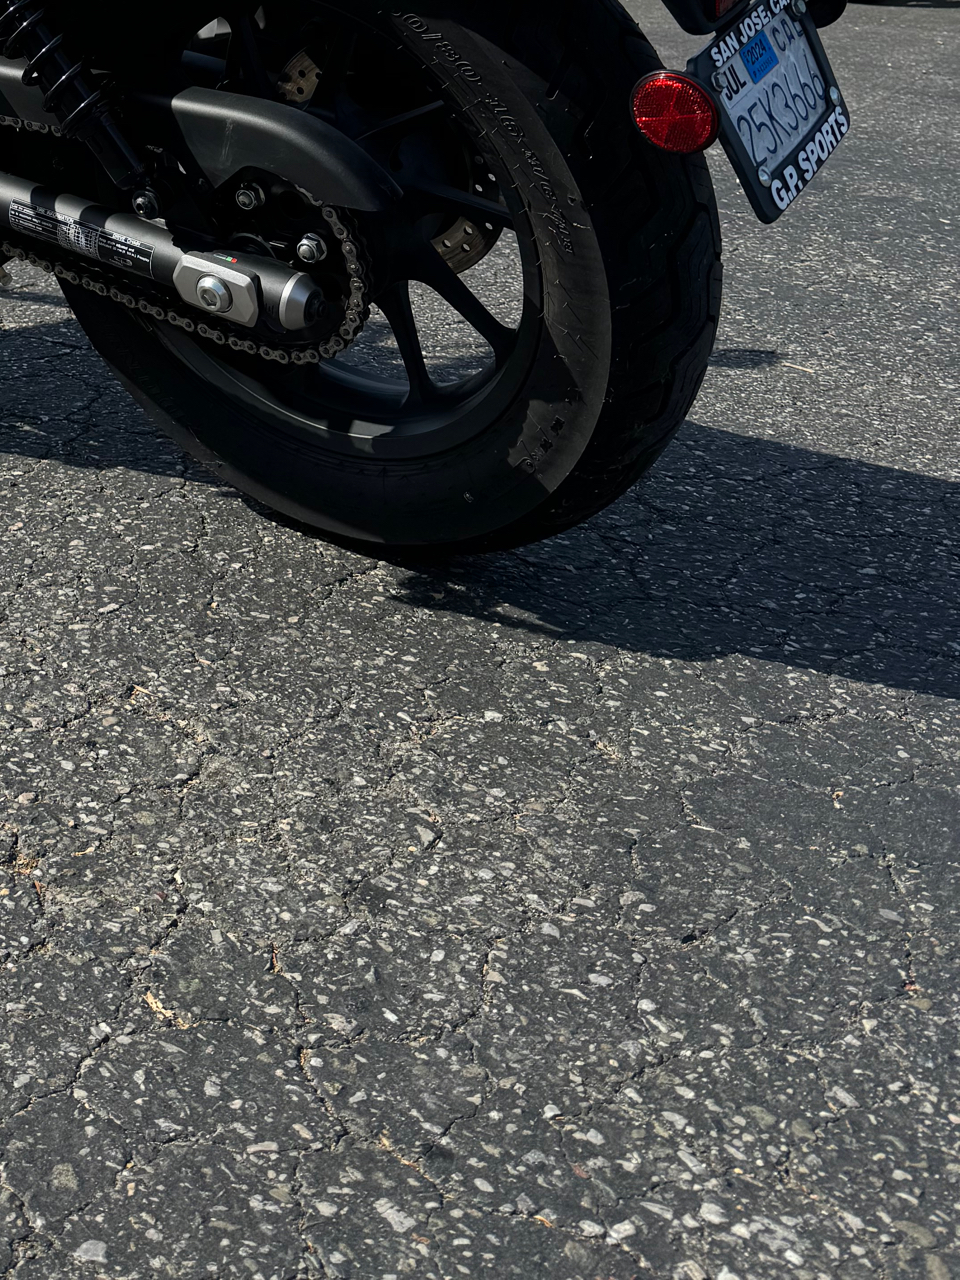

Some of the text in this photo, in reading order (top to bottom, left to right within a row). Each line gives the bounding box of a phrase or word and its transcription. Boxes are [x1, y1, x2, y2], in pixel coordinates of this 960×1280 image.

[710, 32, 740, 68] SAN
[738, 5, 772, 44] JOSE,
[746, 39, 767, 65] 2024
[723, 64, 747, 101] JUL
[736, 48, 826, 168] 25K3666
[770, 106, 848, 211] G.P. SPORTS
